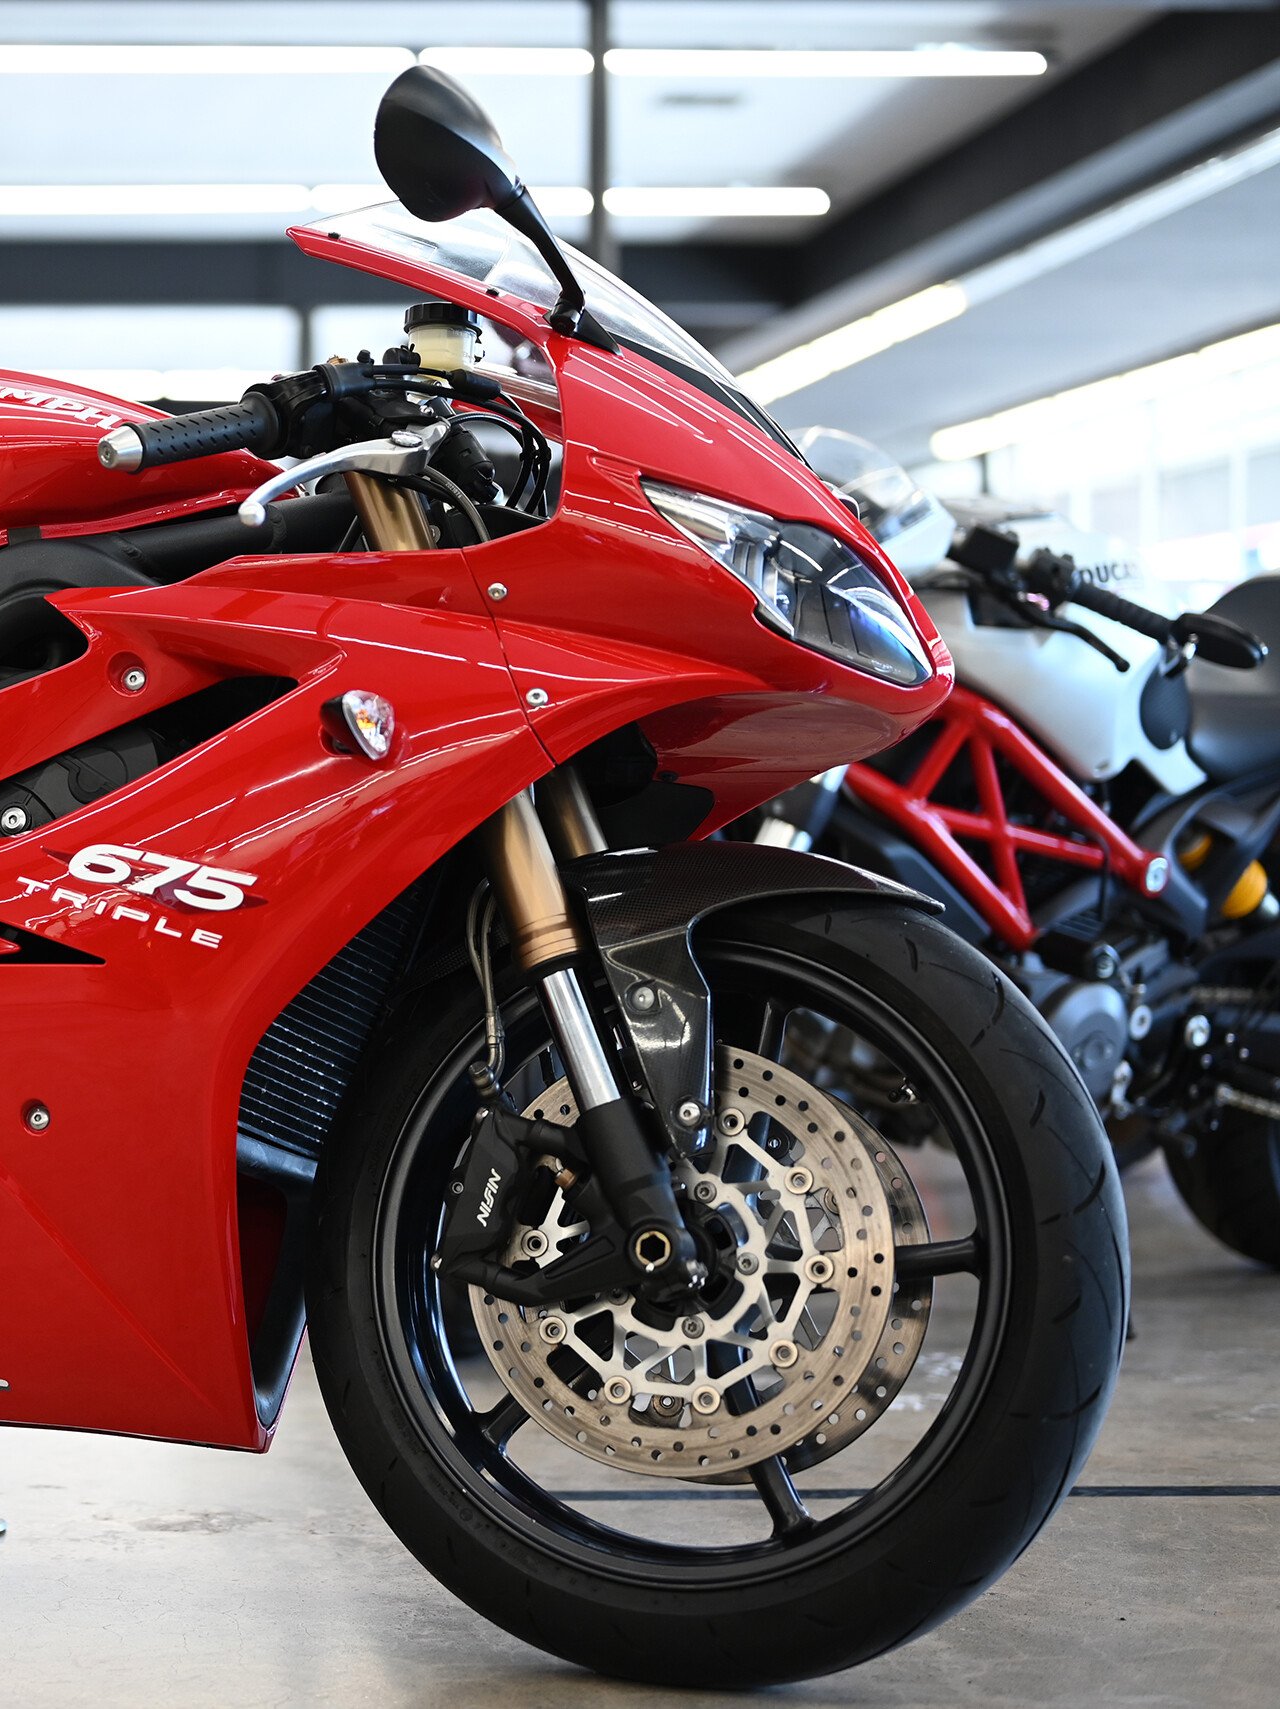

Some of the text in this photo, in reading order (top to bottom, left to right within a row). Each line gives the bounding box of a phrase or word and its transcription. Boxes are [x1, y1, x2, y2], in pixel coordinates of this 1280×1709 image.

[68, 843, 259, 911] 675
[17, 876, 223, 949] TRIPLE
[476, 1167, 501, 1228] NISSIN
